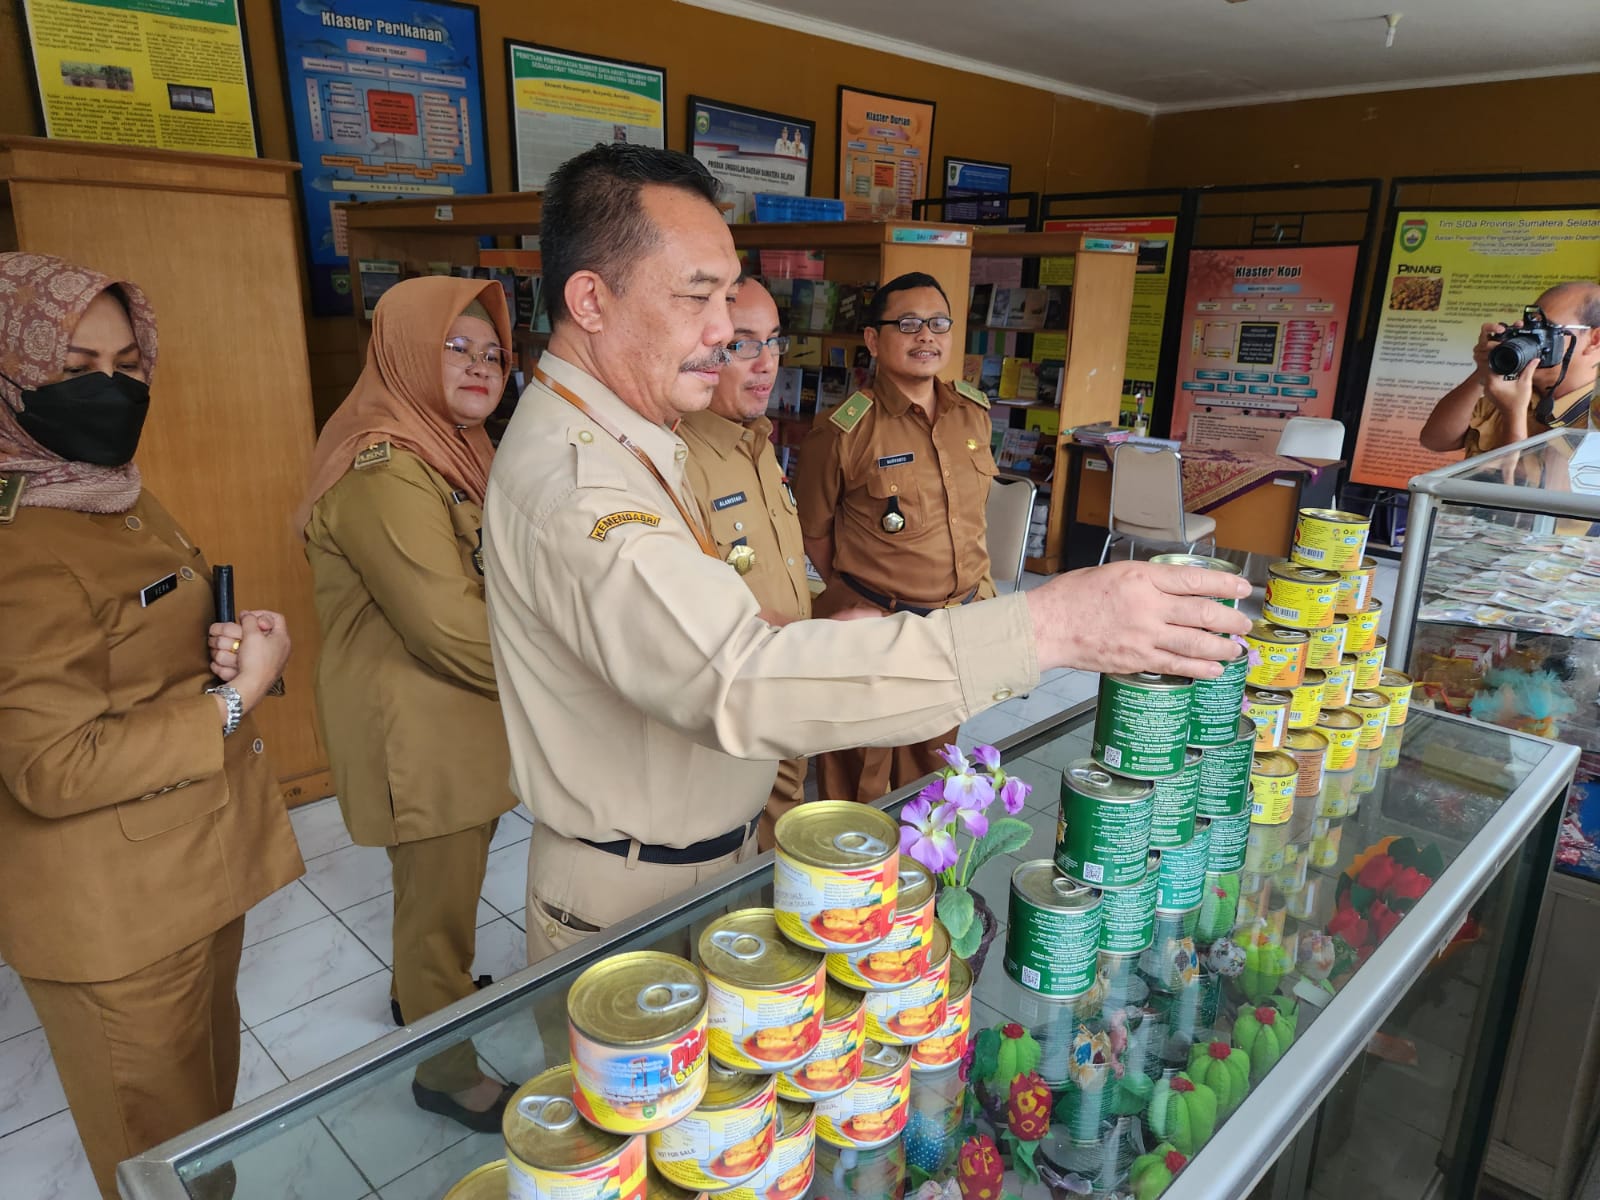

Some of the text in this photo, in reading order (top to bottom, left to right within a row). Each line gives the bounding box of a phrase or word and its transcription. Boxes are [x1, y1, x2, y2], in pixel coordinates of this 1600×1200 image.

[321, 11, 443, 43] Klaster Perikanan
[866, 111, 911, 127] Klaster Durian
[1480, 219, 1515, 228] Provinsi
[1518, 219, 1563, 228] Sumatera
[1235, 265, 1302, 278] Klaster Kopi
[1397, 264, 1442, 274] PINANG
[594, 513, 657, 538] KEMENDAGRI
[679, 1148, 697, 1156] SALE
